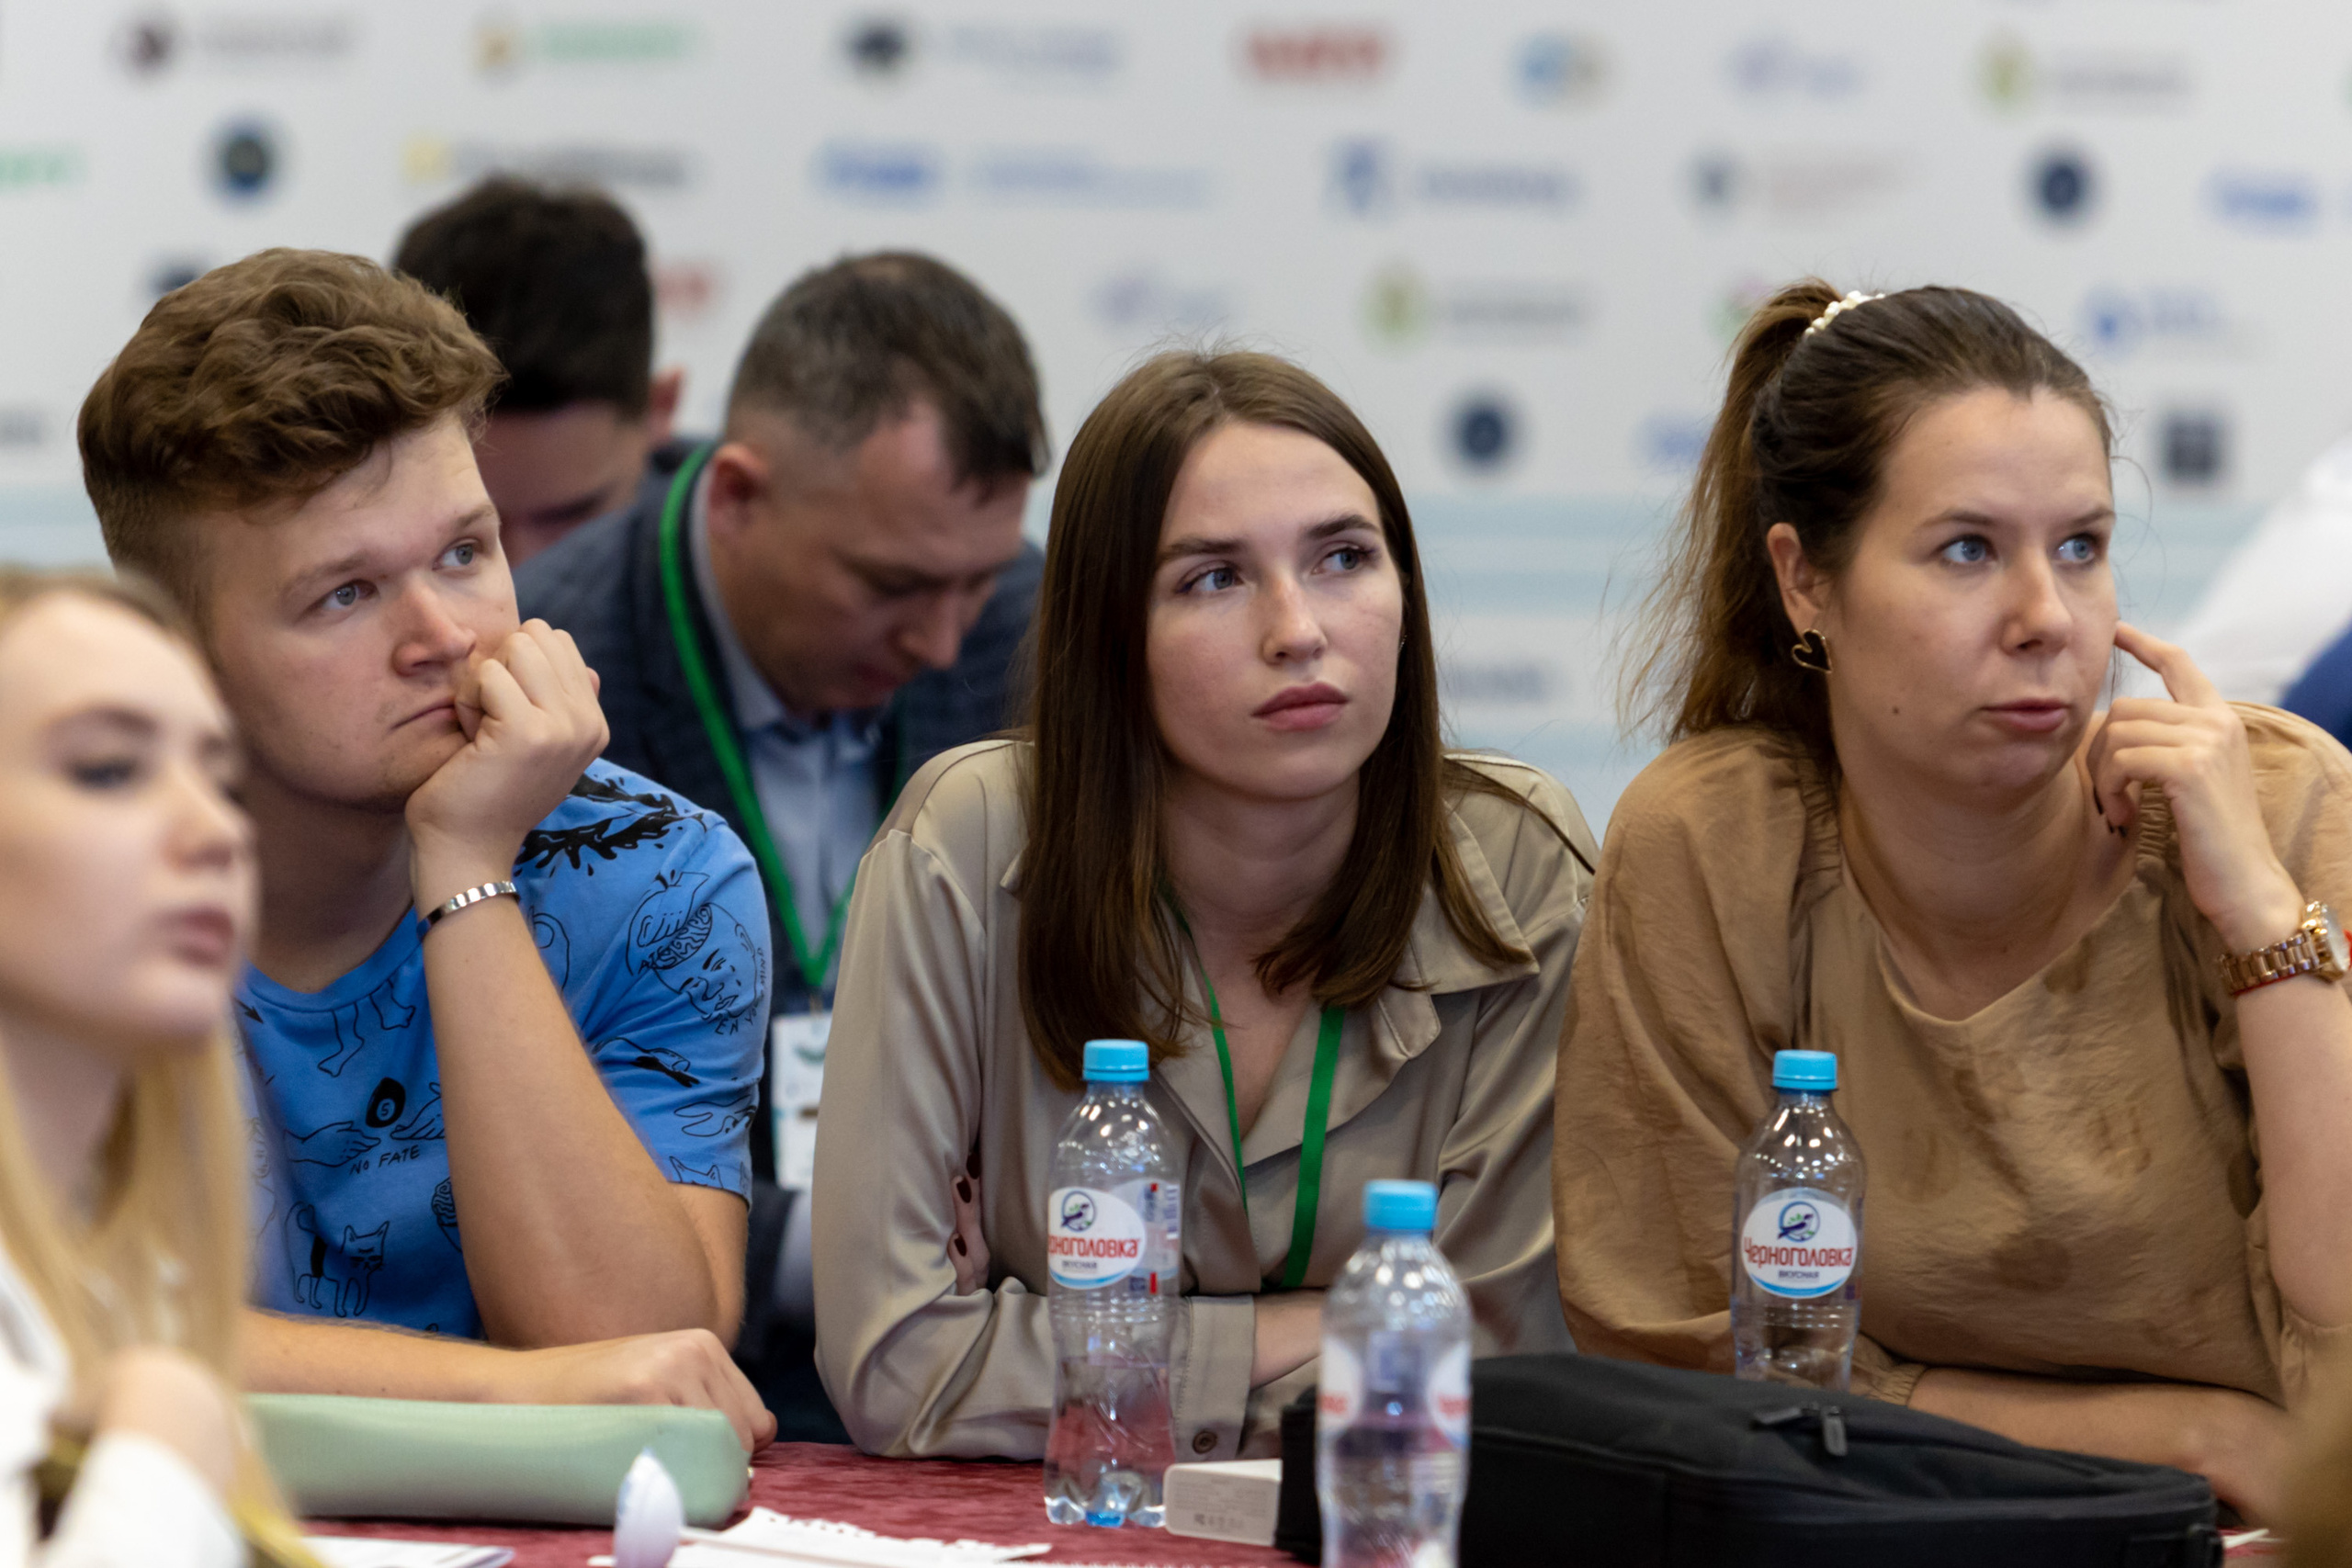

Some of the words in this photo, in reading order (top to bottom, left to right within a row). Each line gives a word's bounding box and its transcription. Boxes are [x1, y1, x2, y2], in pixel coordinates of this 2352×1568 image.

[350, 1159, 369, 1175] NO
[379, 1145, 420, 1168] FATE
[1744, 1236, 1853, 1269] Черноголовка
